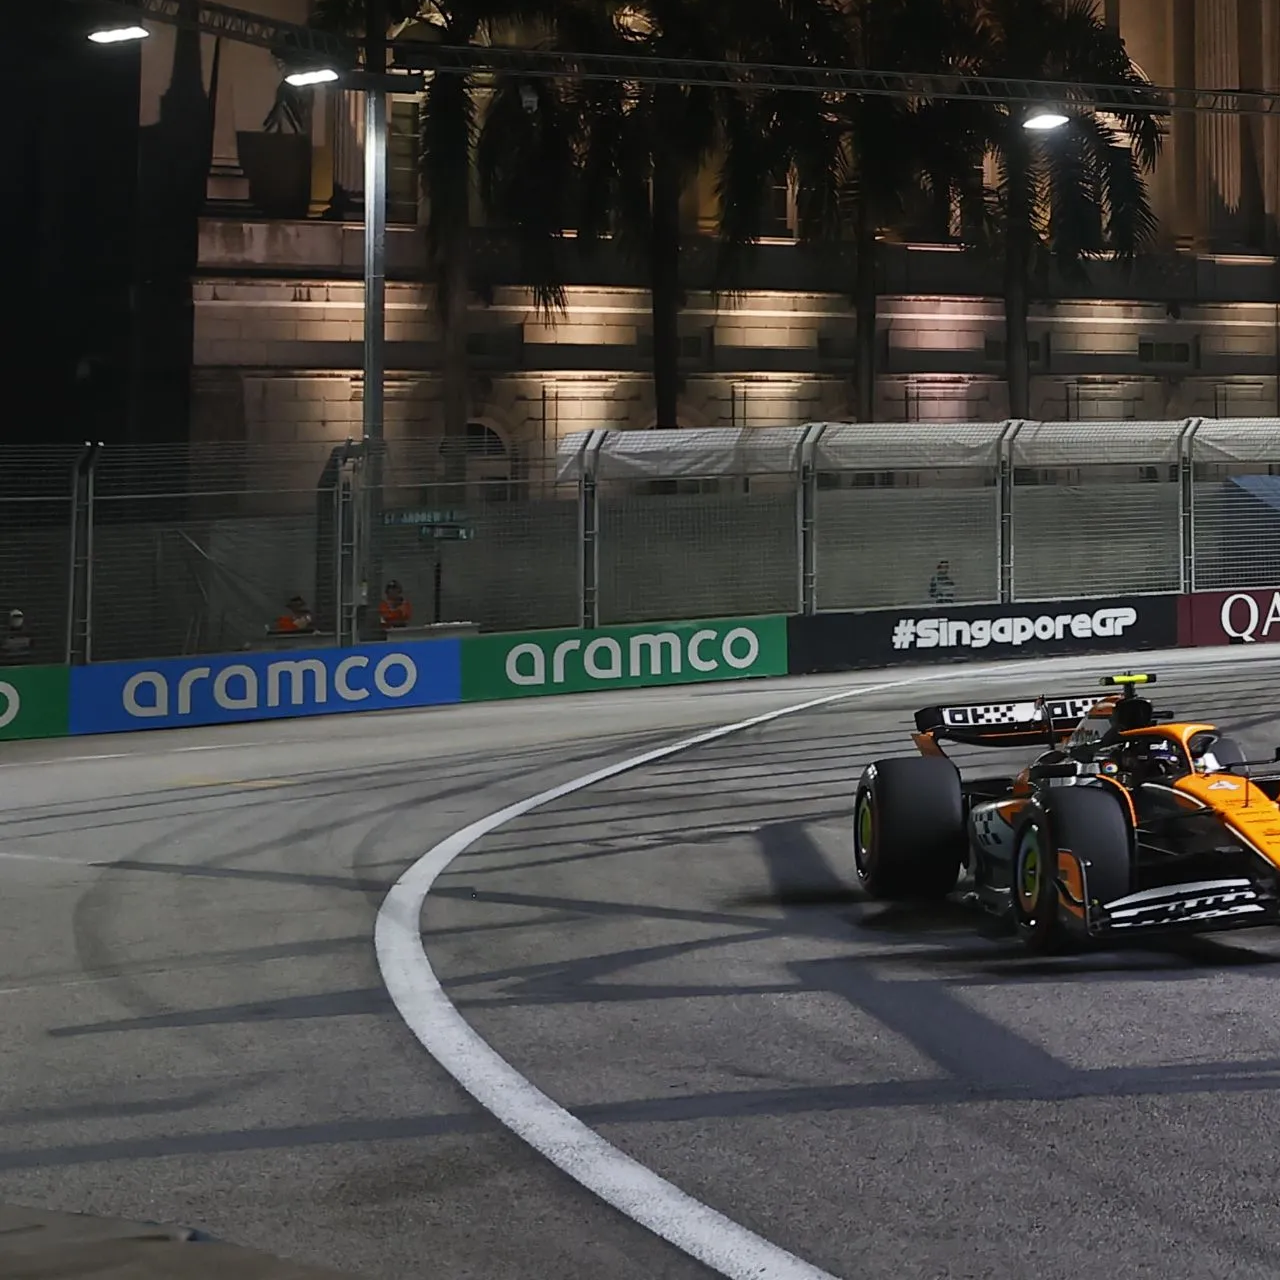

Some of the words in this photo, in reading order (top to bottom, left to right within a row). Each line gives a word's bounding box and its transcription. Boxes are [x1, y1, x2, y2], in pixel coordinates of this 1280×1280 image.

[505, 627, 759, 685] aramco
[892, 607, 1137, 649] #SingaporeGP
[123, 653, 417, 717] aramco
